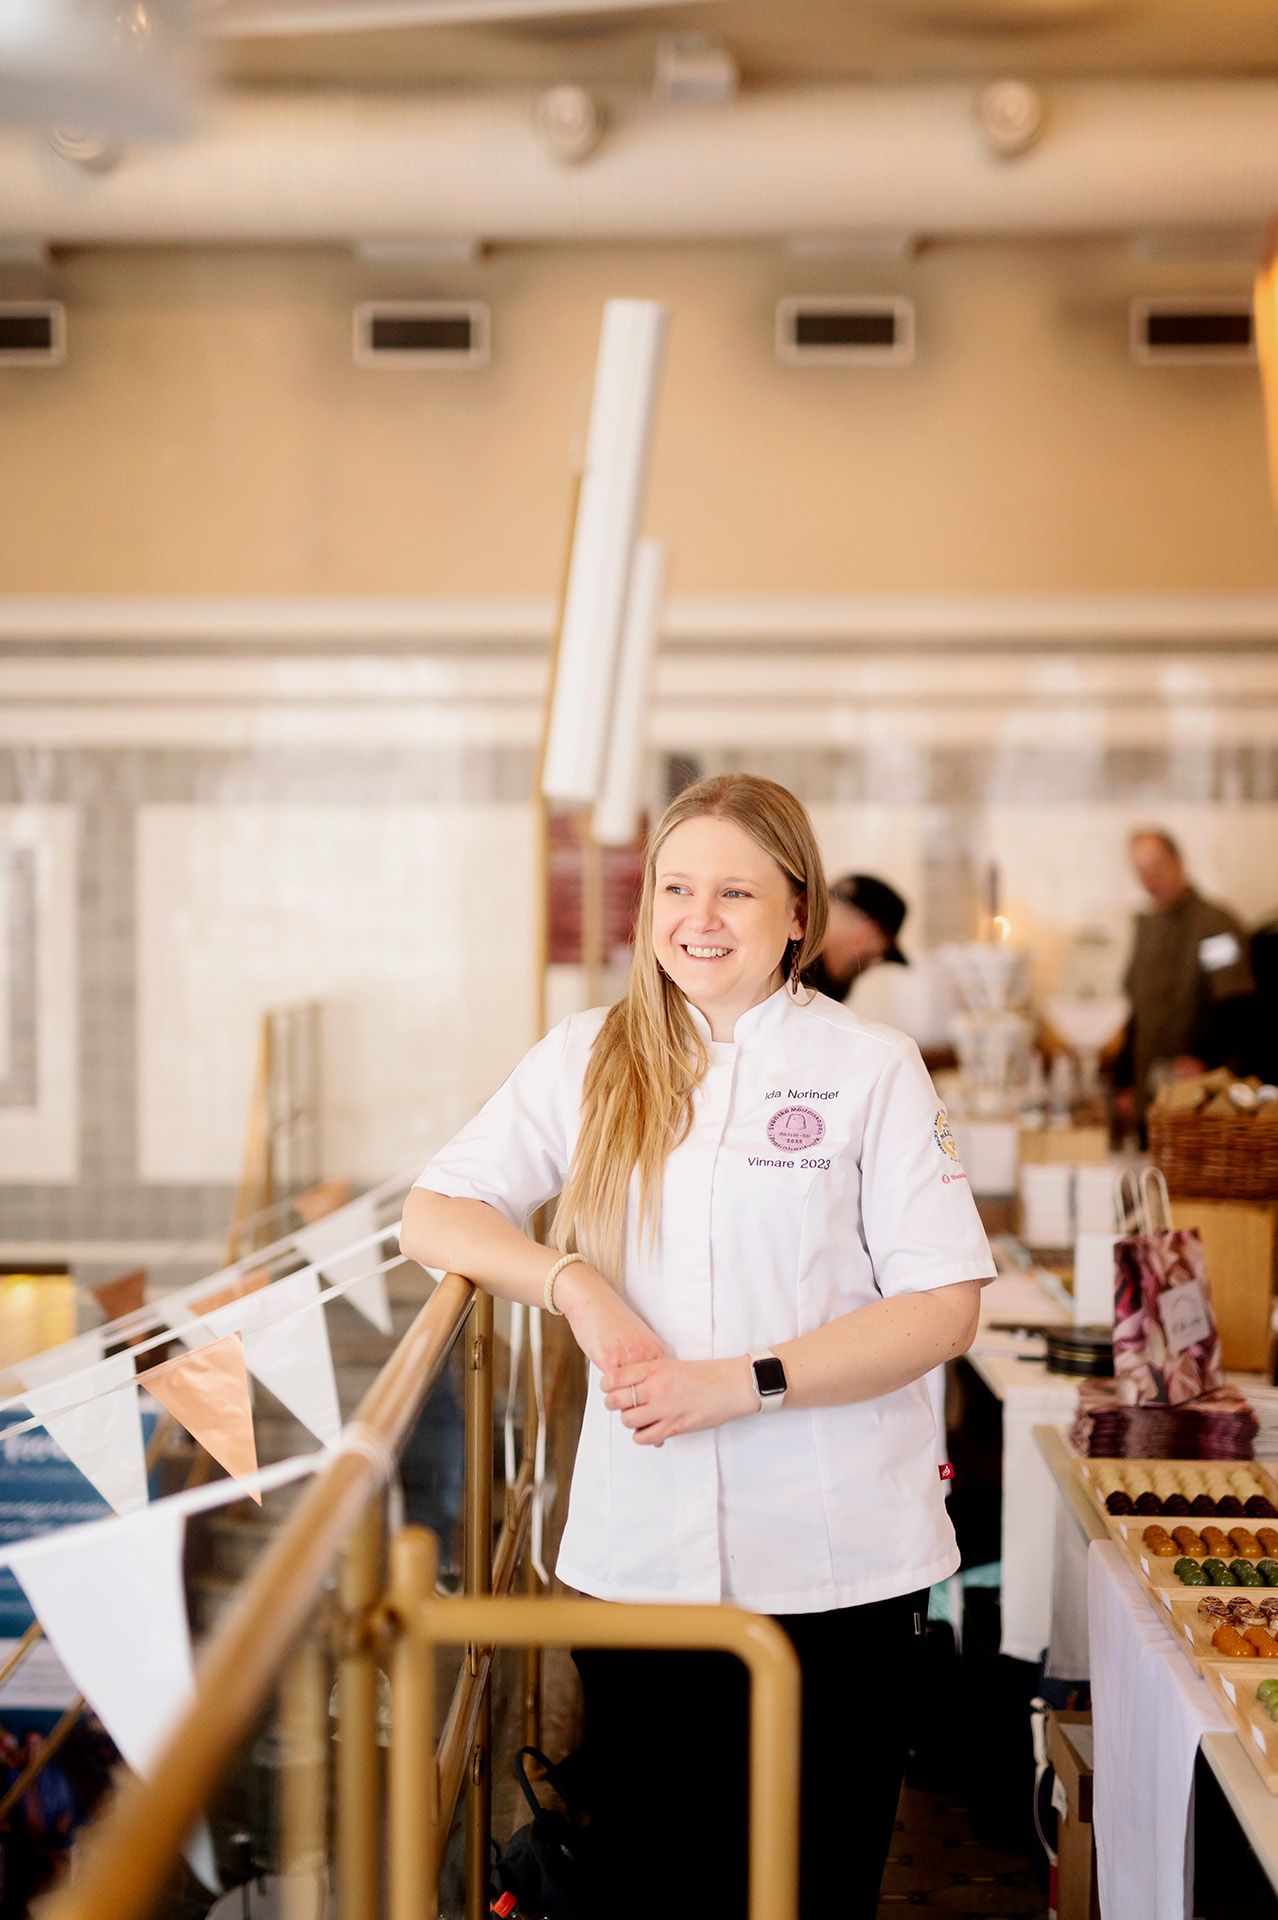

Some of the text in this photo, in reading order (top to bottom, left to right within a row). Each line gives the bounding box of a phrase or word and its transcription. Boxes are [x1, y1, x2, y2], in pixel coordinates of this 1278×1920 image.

[764, 1089, 840, 1100] Ida Norinder
[747, 1157, 831, 1171] Vinnare 2023
